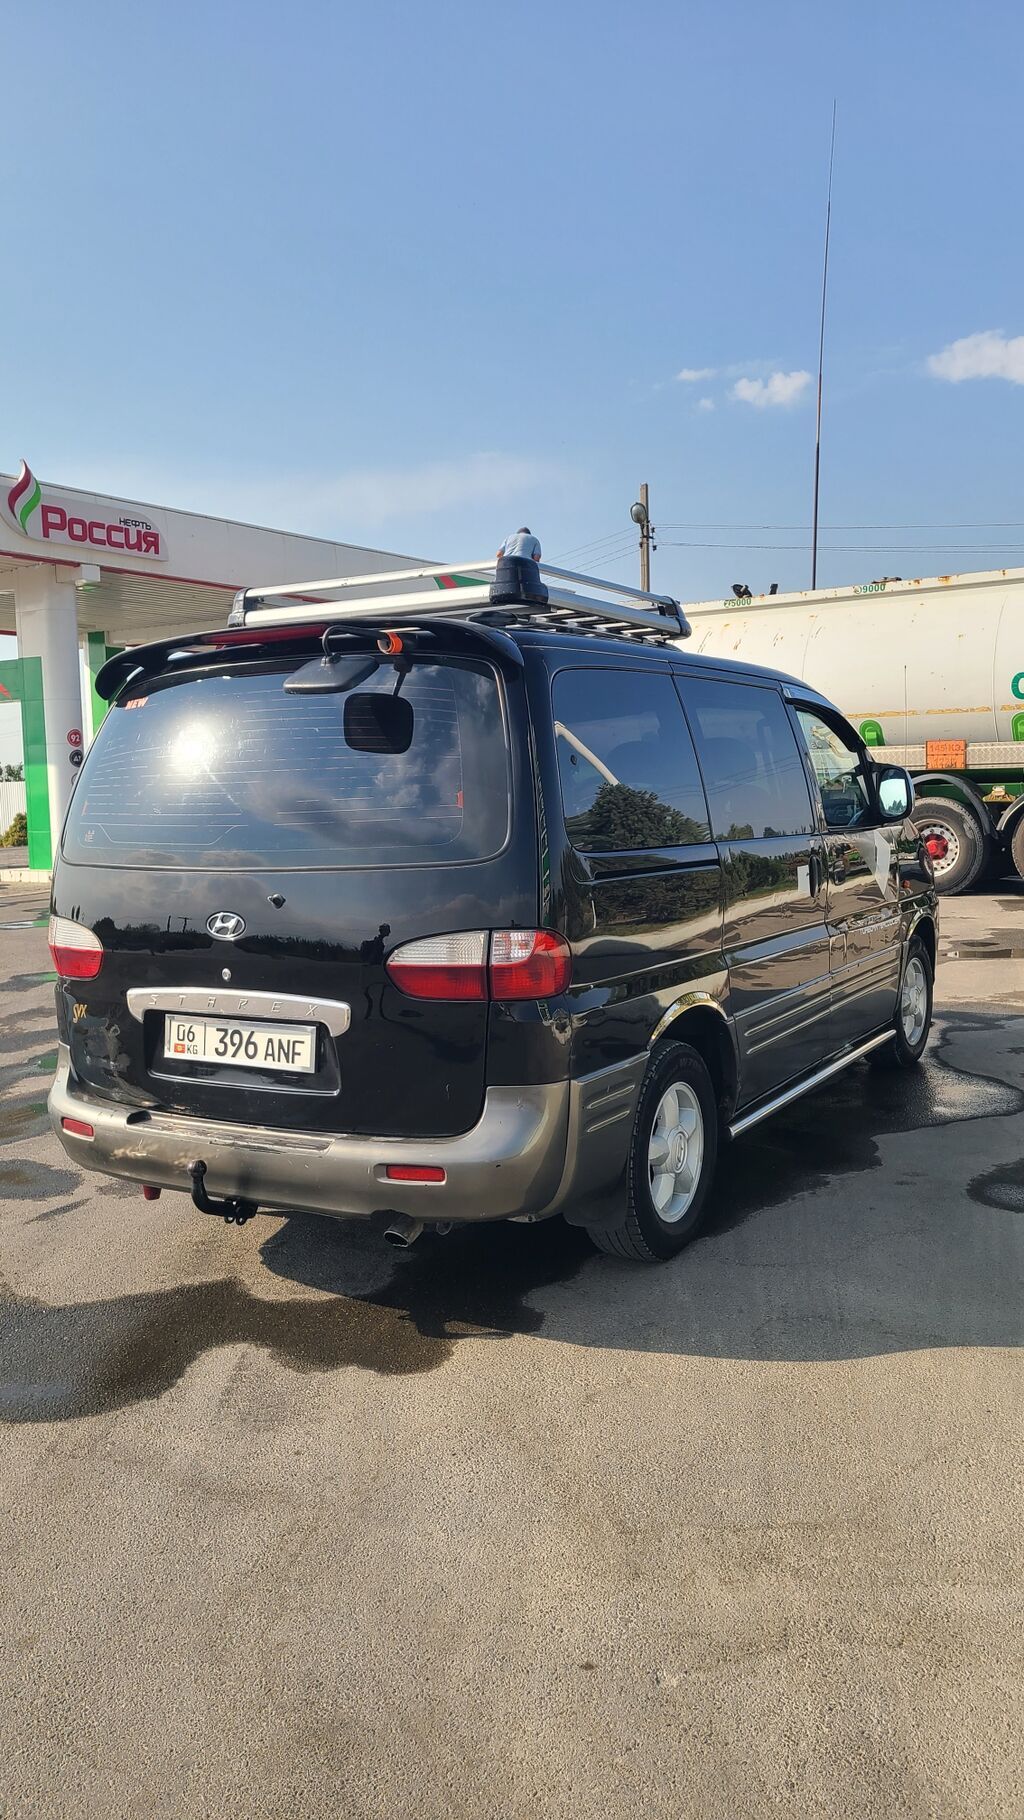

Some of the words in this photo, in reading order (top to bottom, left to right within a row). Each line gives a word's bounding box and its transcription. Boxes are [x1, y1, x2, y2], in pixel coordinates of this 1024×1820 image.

[41, 504, 159, 555] Россия
[119, 517, 152, 530] НЕФТЬ
[862, 583, 886, 593] 9000
[125, 697, 148, 710] NEW
[70, 734, 80, 743] 92
[149, 994, 318, 1016] STAREX
[73, 1003, 88, 1023] SVX
[176, 1023, 196, 1043] 06
[214, 1027, 259, 1060] 396
[264, 1037, 305, 1065] ANF
[186, 1043, 198, 1055] KG
